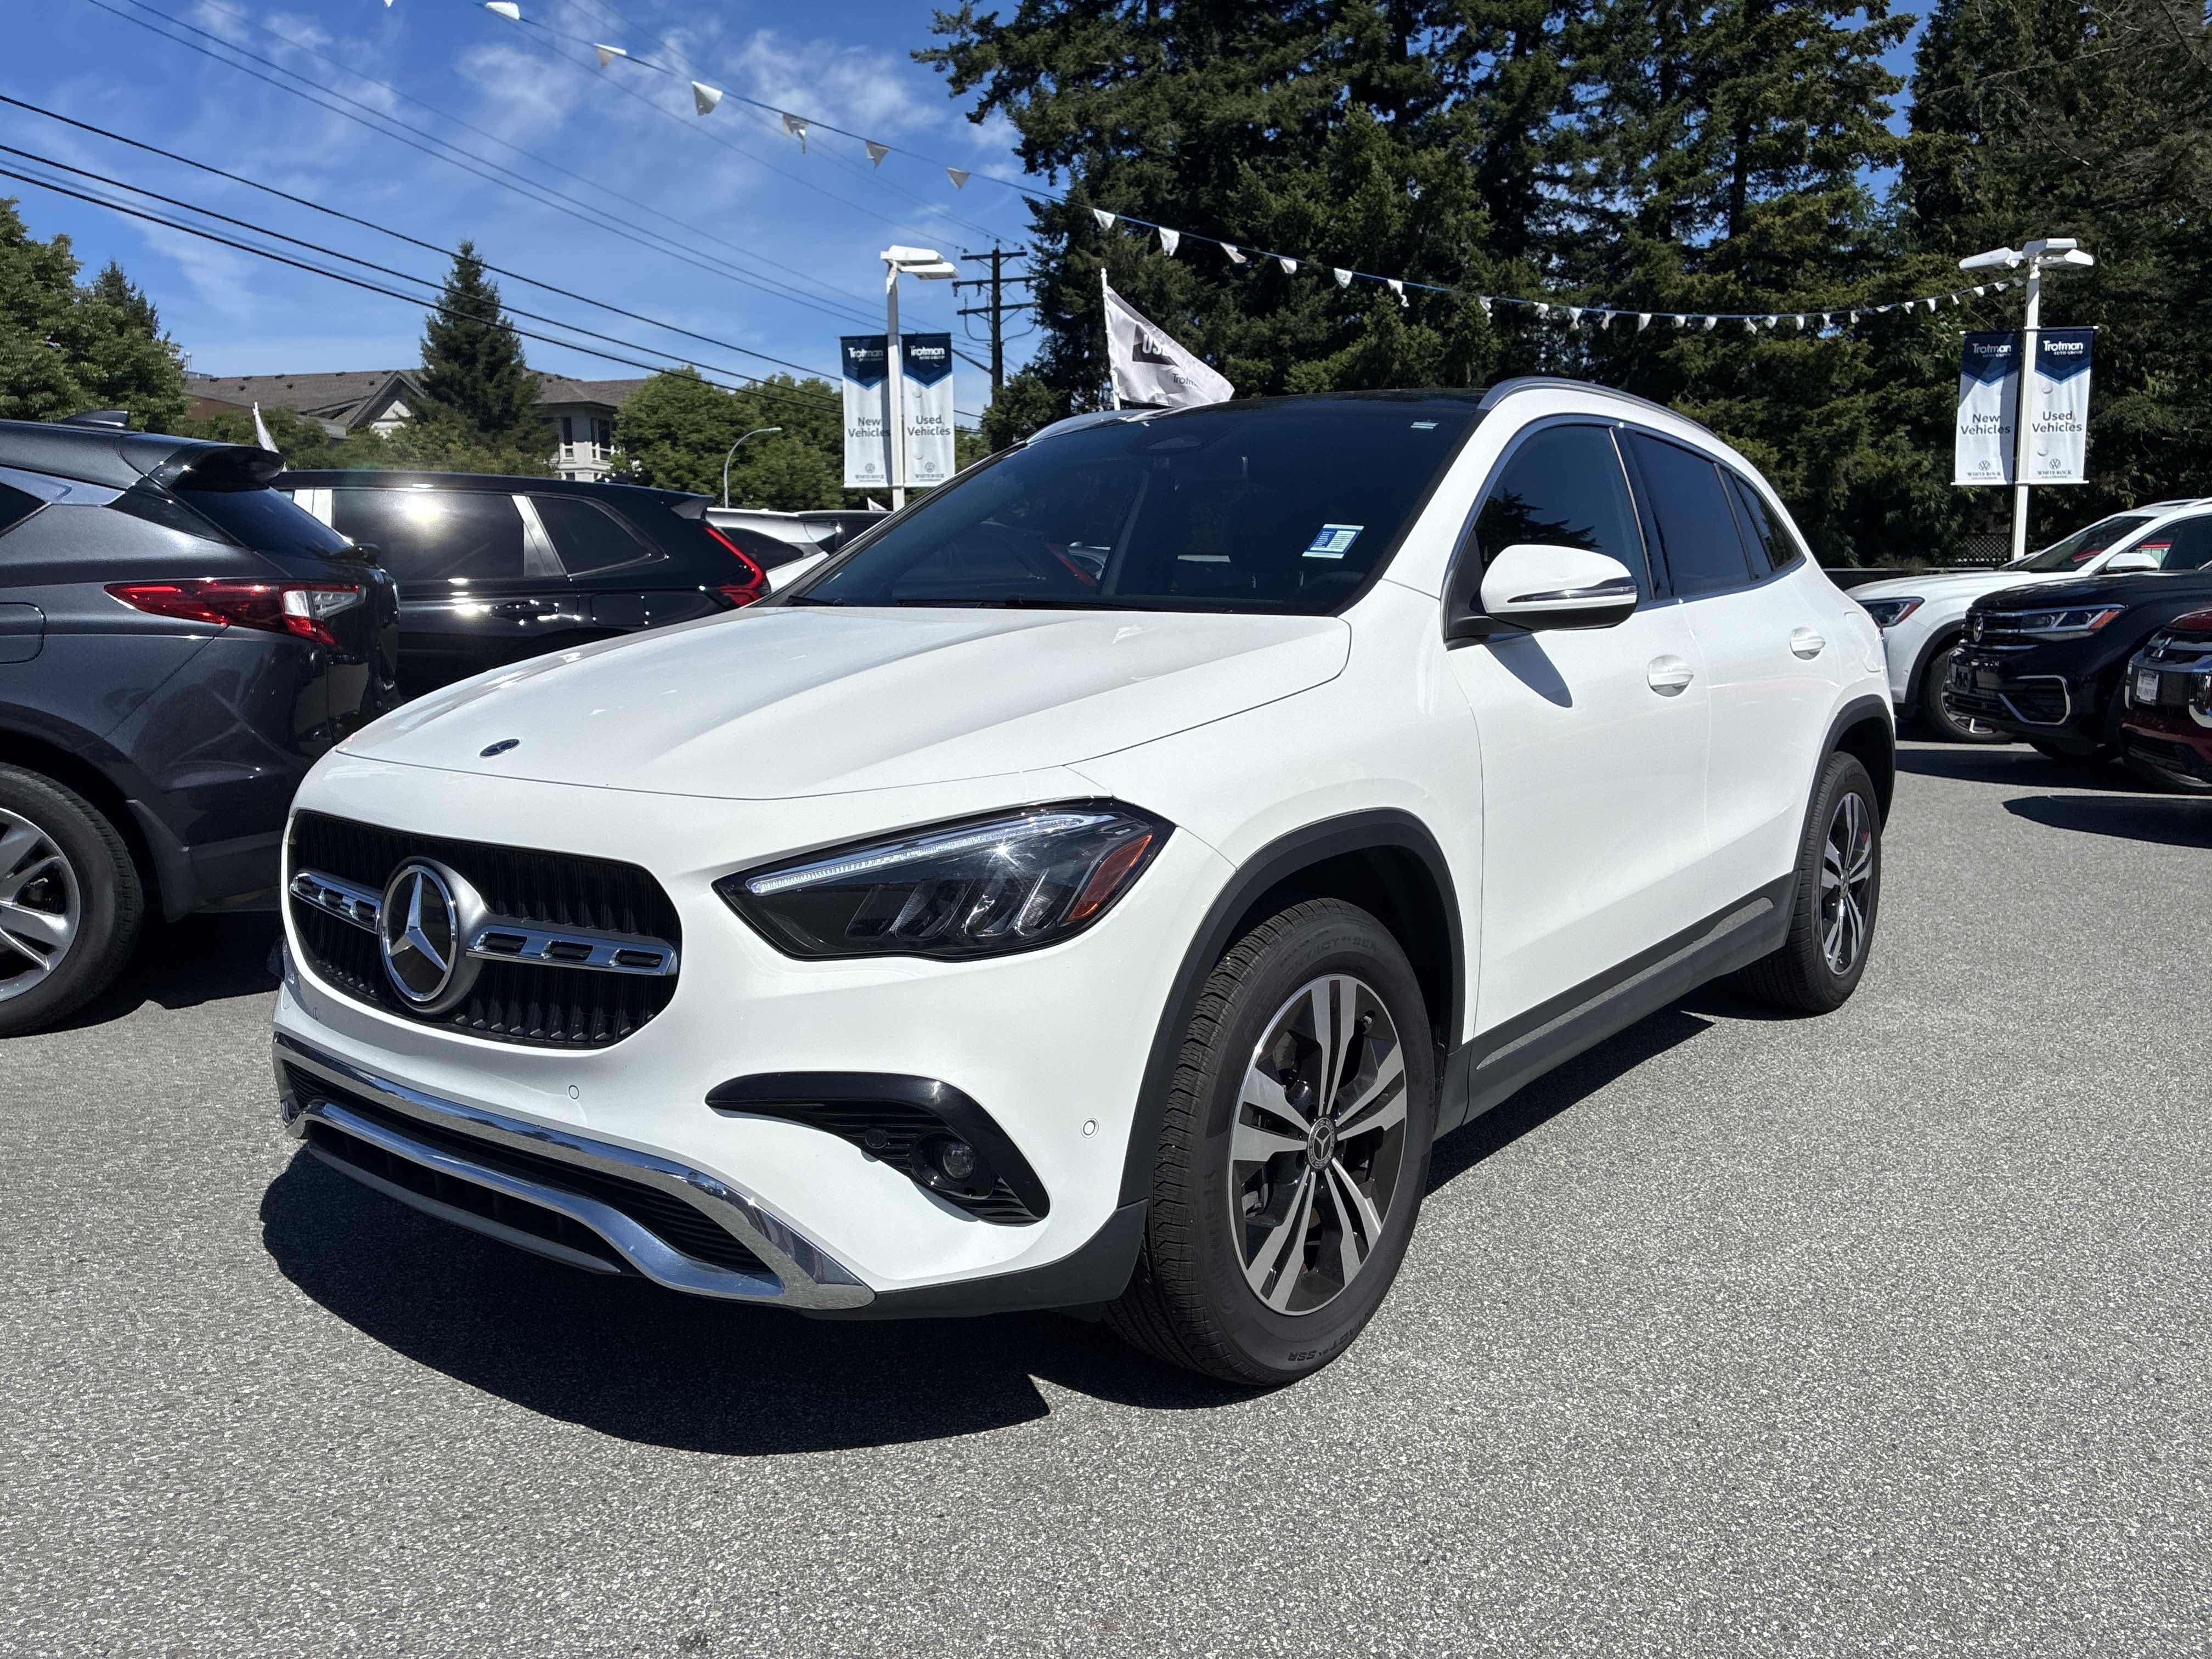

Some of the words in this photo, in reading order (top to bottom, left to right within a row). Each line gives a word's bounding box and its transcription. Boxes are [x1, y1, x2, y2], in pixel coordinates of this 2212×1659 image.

[909, 346, 945, 356] Trotman
[1972, 343, 2011, 354] Trotman
[2042, 340, 2084, 352] Trotman
[848, 347, 884, 358] Trotman
[857, 416, 881, 426] New
[916, 415, 942, 425] Used
[1972, 413, 2001, 424] New
[2042, 411, 2073, 421] Used
[848, 427, 891, 438] Vehicles
[907, 426, 951, 436] Vehicles
[1960, 425, 2011, 435] Vehicles
[2032, 422, 2083, 433] Vehicles
